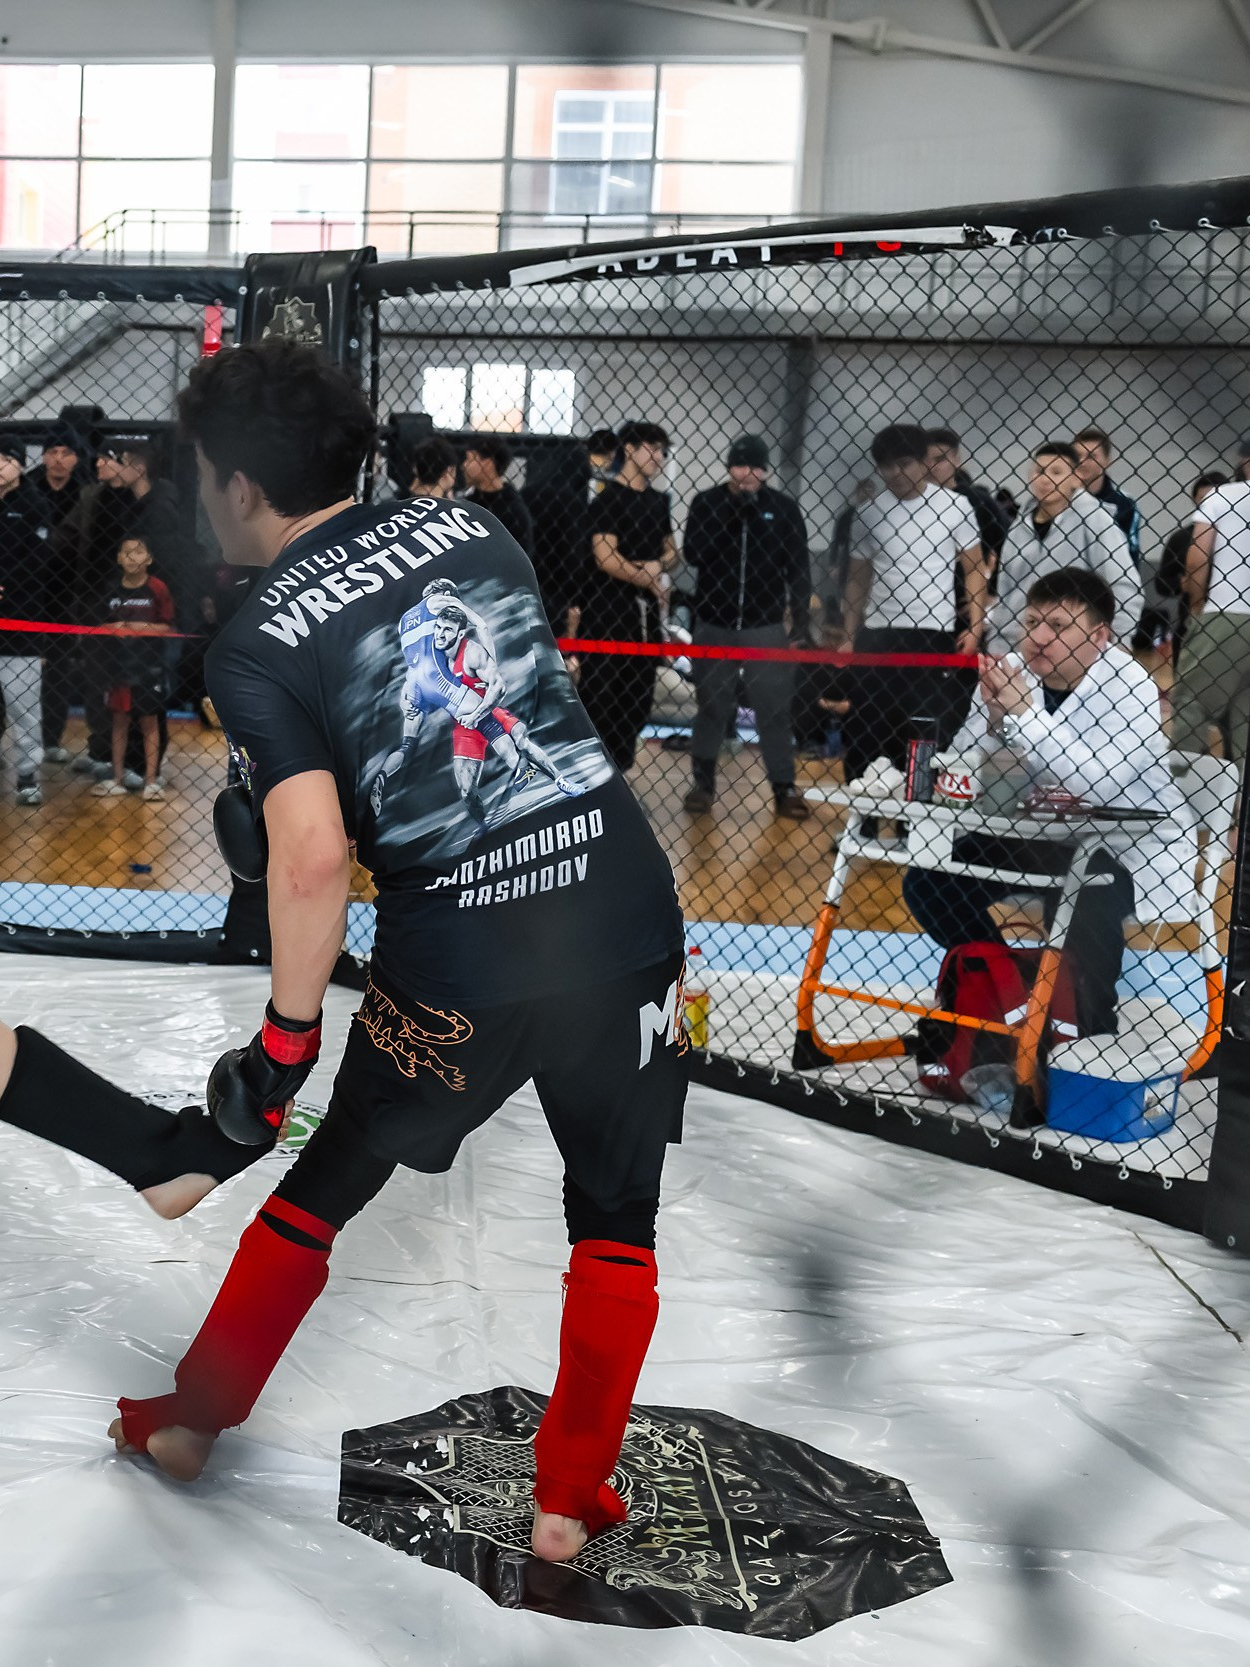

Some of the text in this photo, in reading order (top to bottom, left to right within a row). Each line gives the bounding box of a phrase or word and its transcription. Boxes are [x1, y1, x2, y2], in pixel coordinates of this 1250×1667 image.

[258, 507, 491, 648] WRESTLING
[260, 497, 439, 608] UNITED WORLD
[459, 853, 589, 909] RASHIDOV
